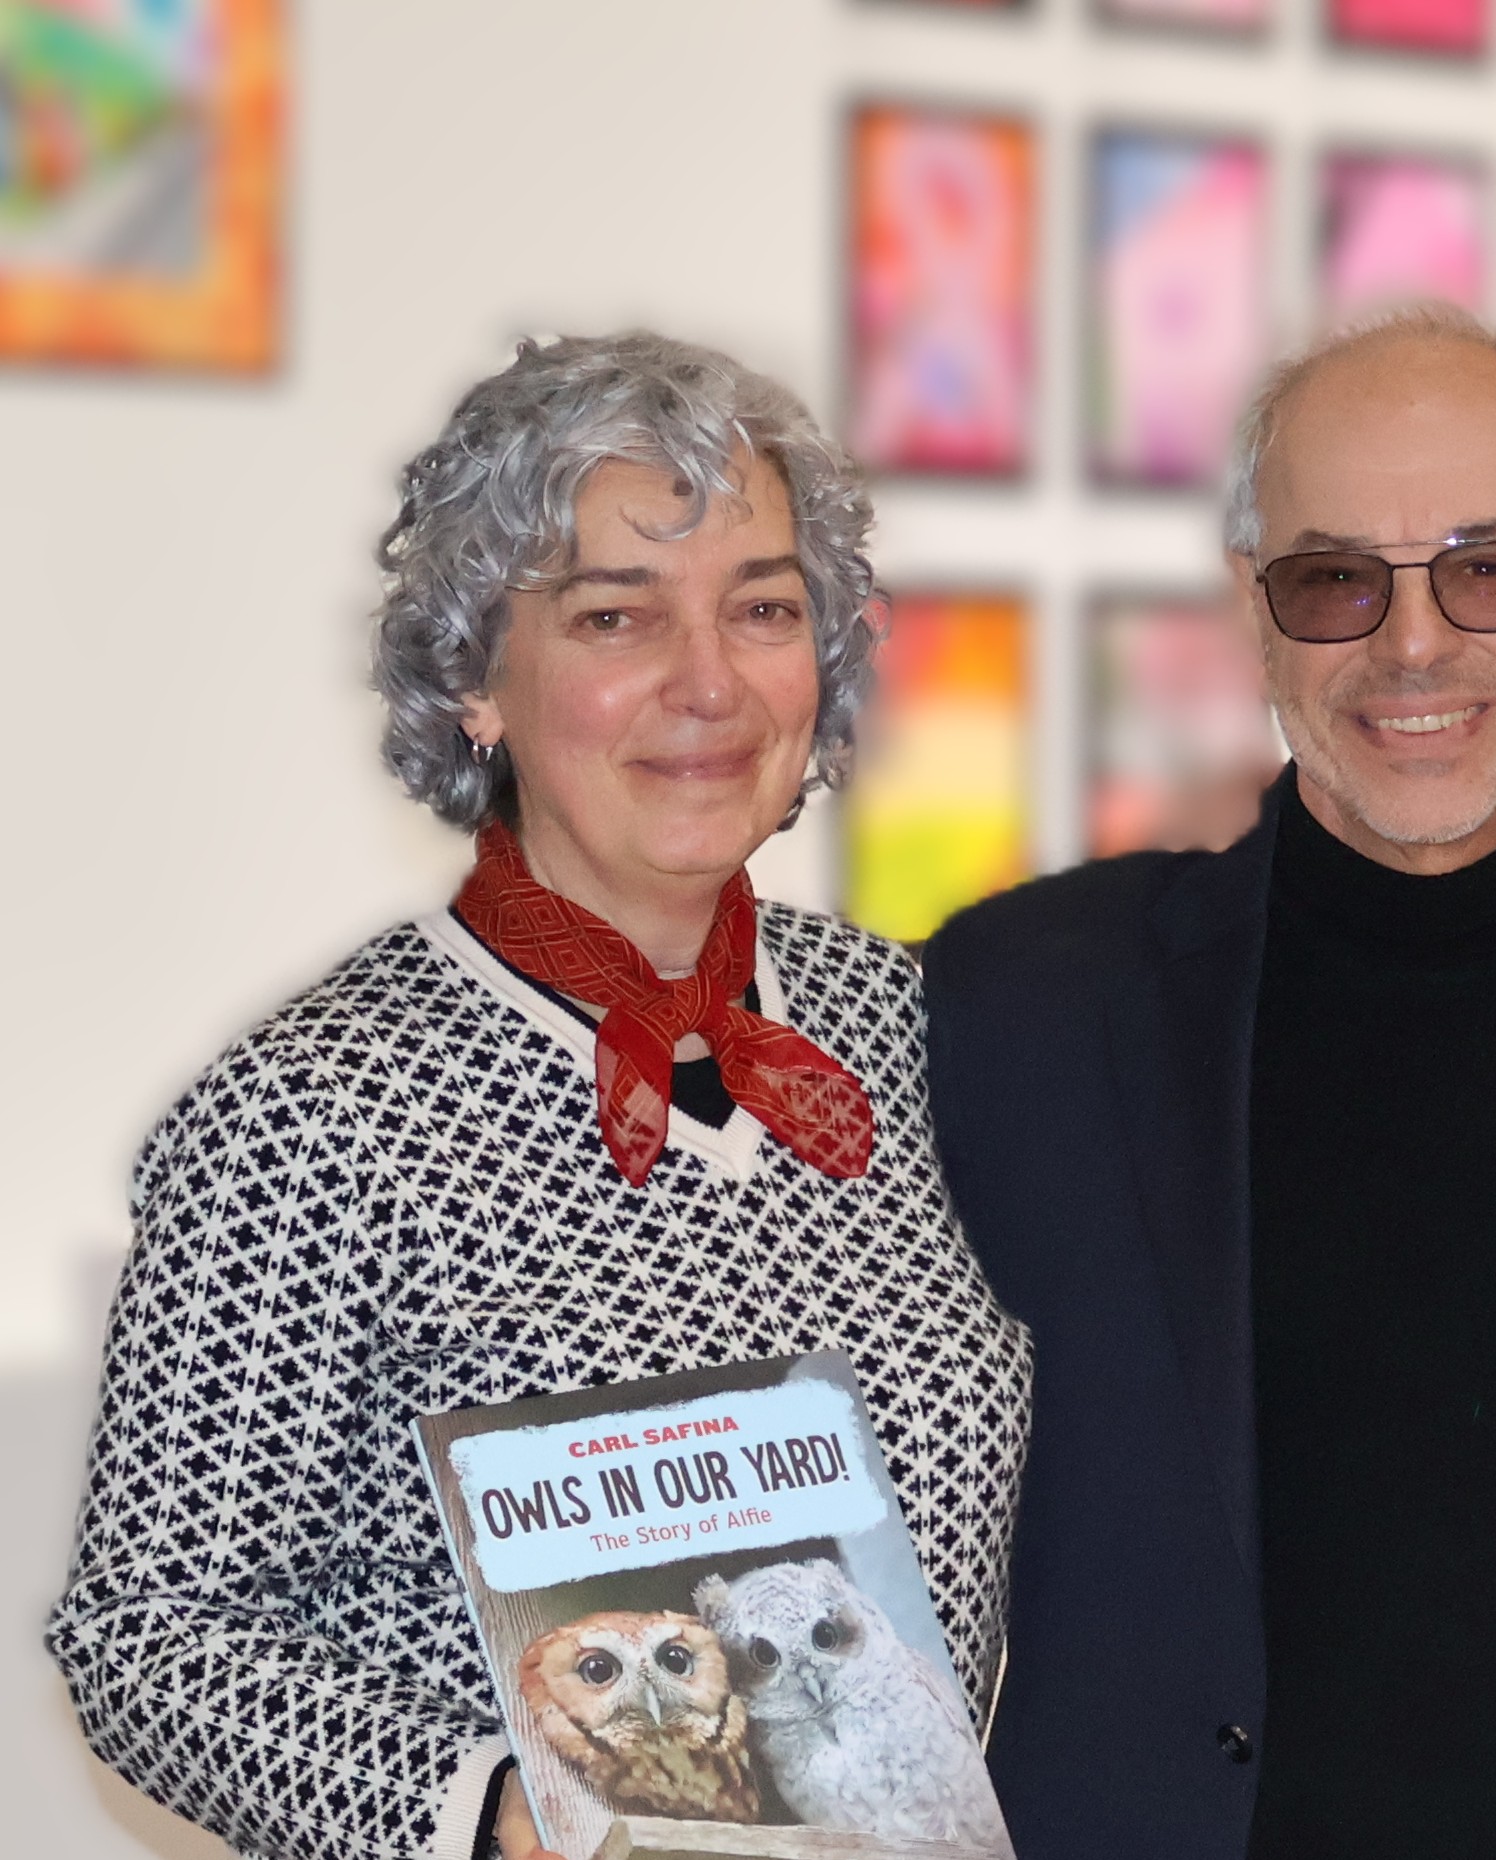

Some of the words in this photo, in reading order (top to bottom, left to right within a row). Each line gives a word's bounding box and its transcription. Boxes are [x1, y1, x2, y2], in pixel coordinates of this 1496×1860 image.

[568, 1434, 638, 1458] CARL
[642, 1416, 740, 1446] SAFINA
[481, 1475, 591, 1540] OWLS
[598, 1464, 645, 1519] IN
[653, 1451, 737, 1509] OUR
[740, 1432, 850, 1493] YARD!
[590, 1534, 630, 1553] The
[637, 1521, 691, 1547] Story
[698, 1514, 720, 1535] of
[727, 1506, 772, 1529] Alfie
